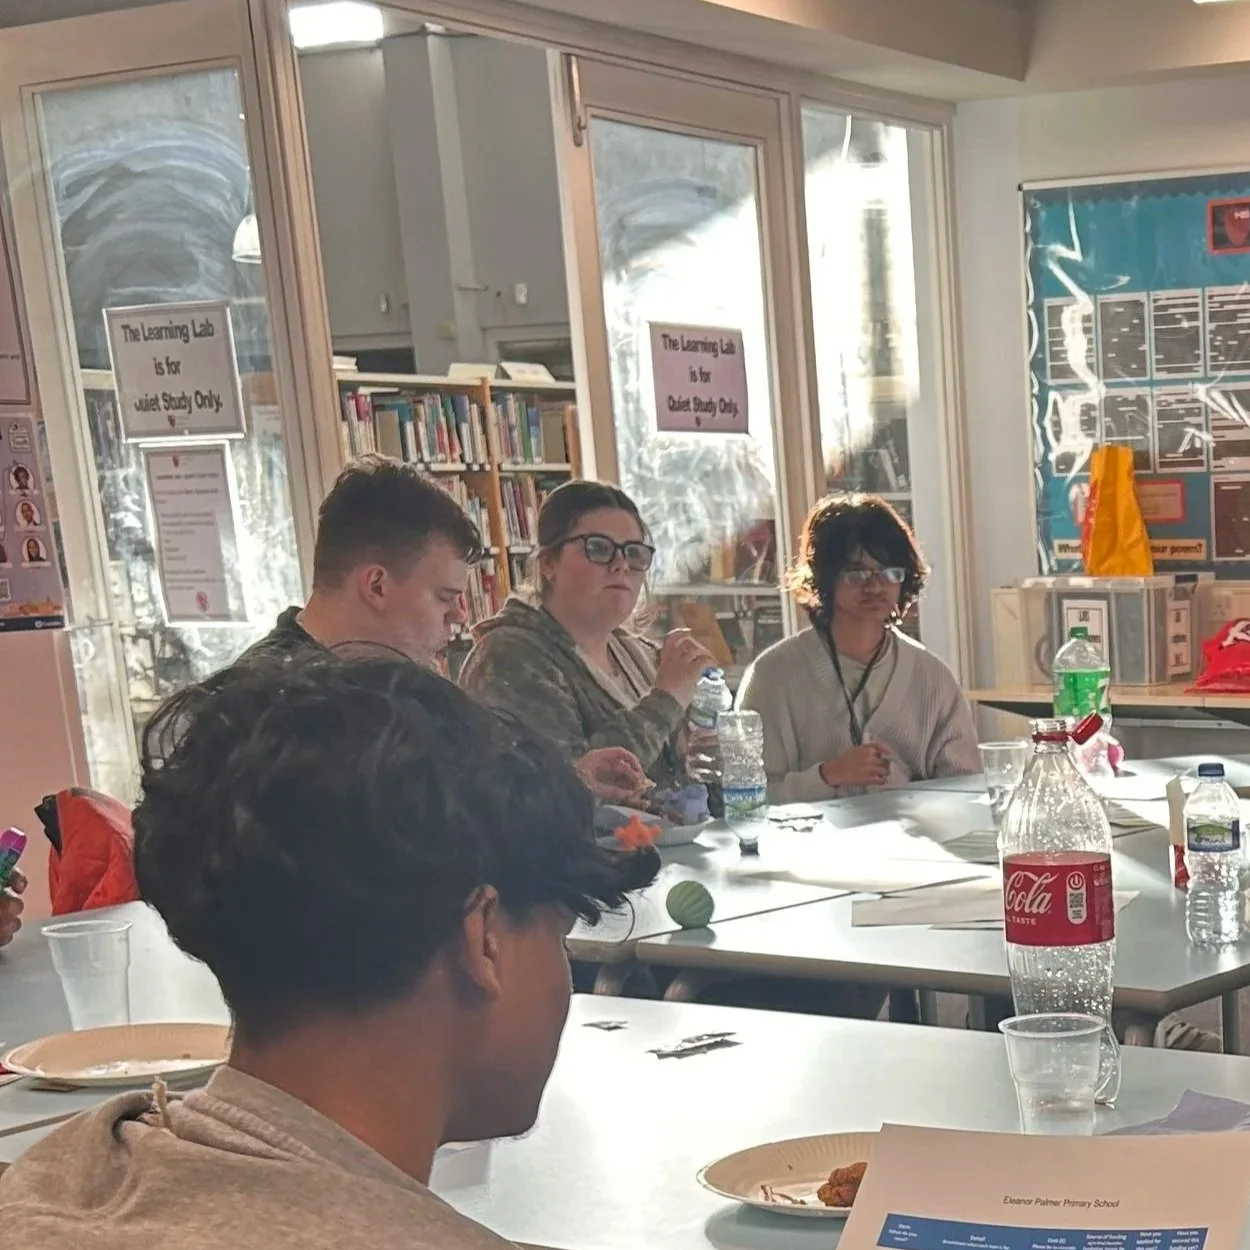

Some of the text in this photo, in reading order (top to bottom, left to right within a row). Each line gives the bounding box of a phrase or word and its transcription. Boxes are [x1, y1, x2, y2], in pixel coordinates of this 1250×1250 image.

[121, 317, 215, 344] The Learning Lab
[661, 333, 737, 358] The Learning Lab
[153, 356, 182, 376] is for
[688, 365, 711, 383] is for
[162, 391, 193, 415] Study
[667, 395, 691, 413] Quiet
[693, 396, 717, 418] Study
[1170, 542, 1204, 556] poem?
[1005, 871, 1059, 914] Cola
[1012, 916, 1037, 926] TASTE
[1003, 1196, 1120, 1209] Eleanor Palmer Primary School
